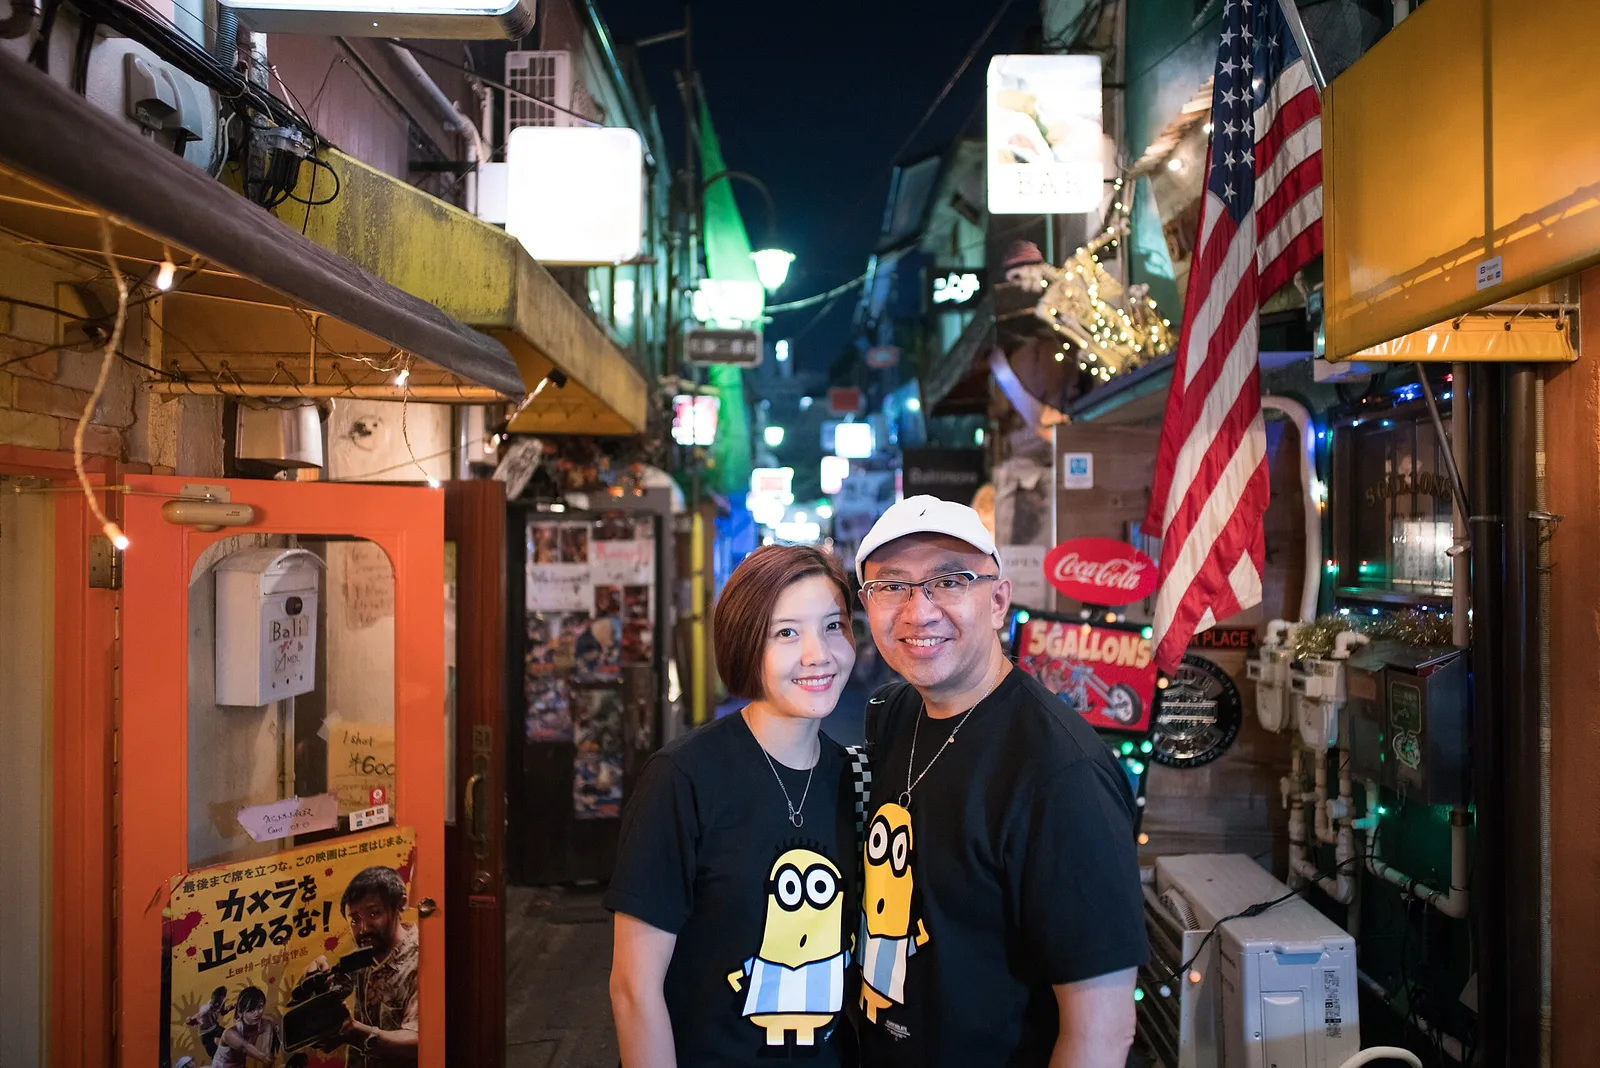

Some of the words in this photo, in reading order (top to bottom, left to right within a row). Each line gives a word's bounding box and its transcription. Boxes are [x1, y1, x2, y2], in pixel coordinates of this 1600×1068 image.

[1017, 171, 1082, 194] BAR
[273, 618, 302, 642] Bali
[1203, 631, 1249, 647] PLACE
[351, 732, 373, 747] shot
[182, 835, 407, 894] 最後まで席を立つな。この映画は二度はじまる。
[216, 875, 317, 922] カメラを
[198, 901, 332, 972] 止めるな!
